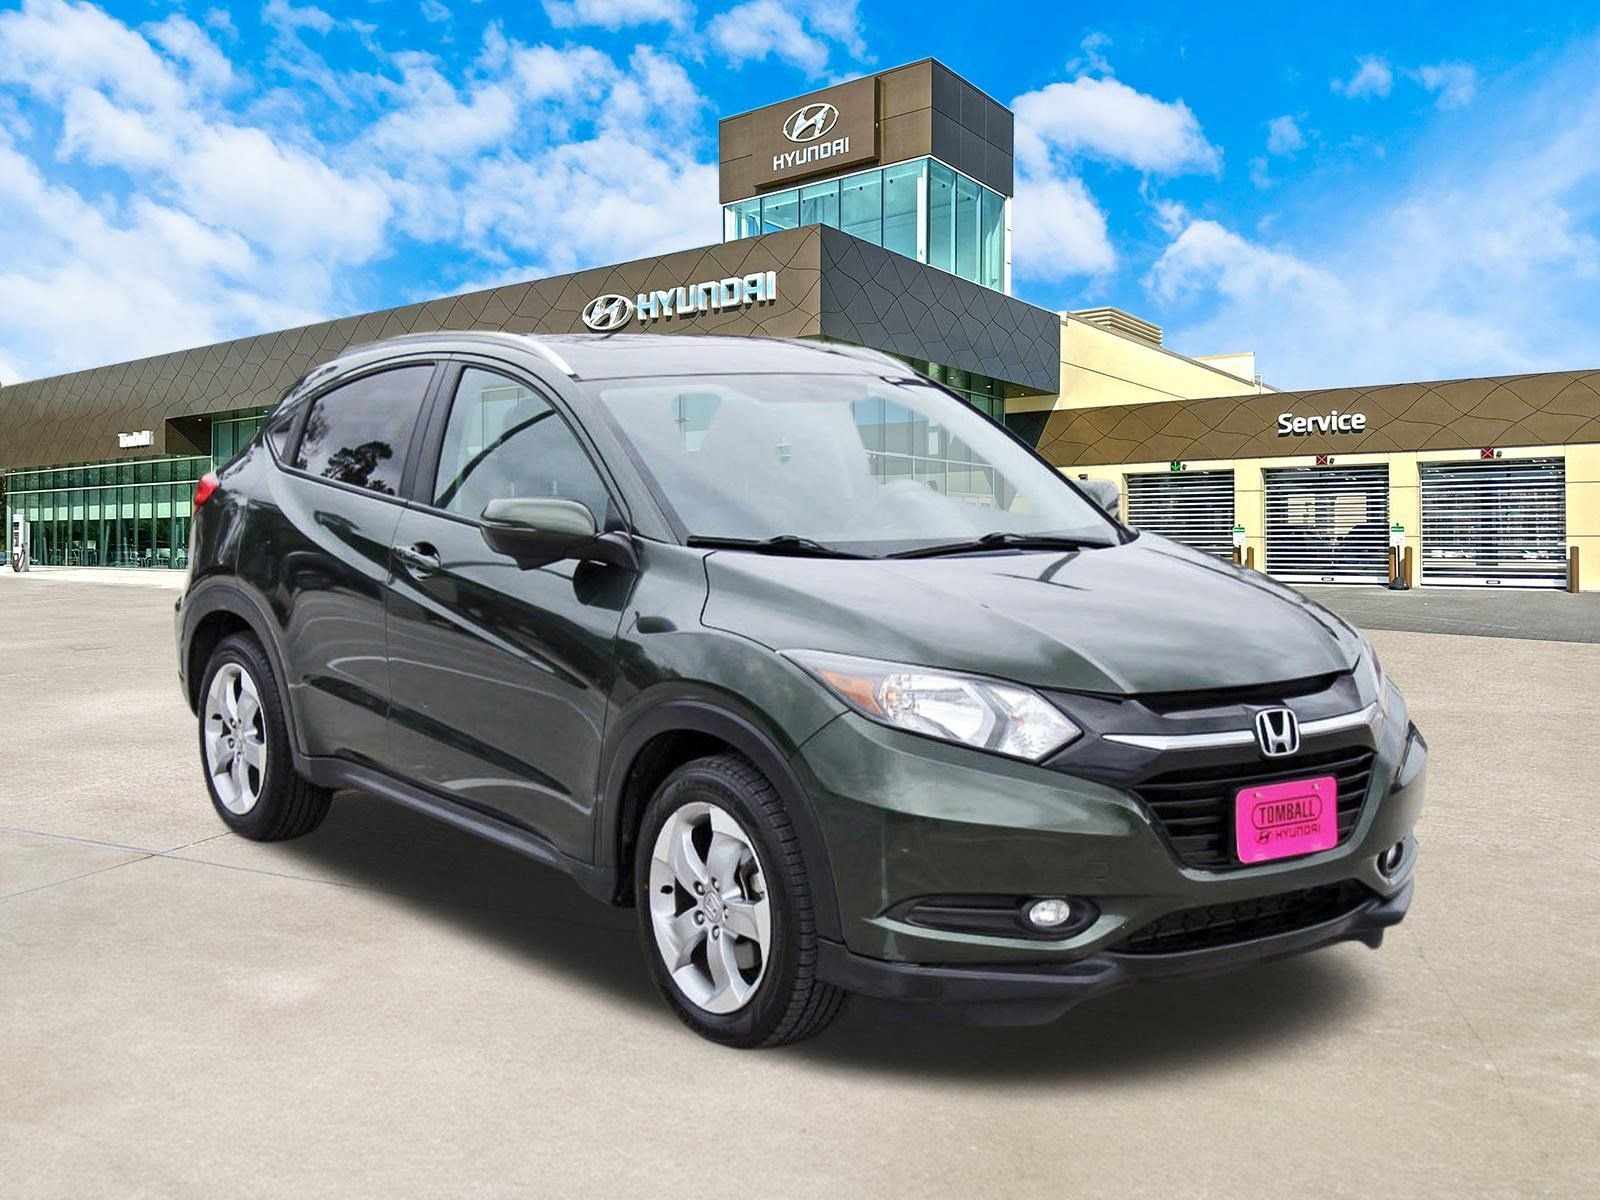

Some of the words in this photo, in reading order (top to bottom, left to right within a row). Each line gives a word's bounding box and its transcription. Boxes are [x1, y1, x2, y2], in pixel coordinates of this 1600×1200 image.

[773, 137, 850, 171] HYUNDAI
[637, 271, 777, 320] HYUNDAI
[1277, 409, 1367, 436] Service
[1259, 799, 1315, 824] TOMBALL
[1275, 823, 1320, 839] HYUNDAI
